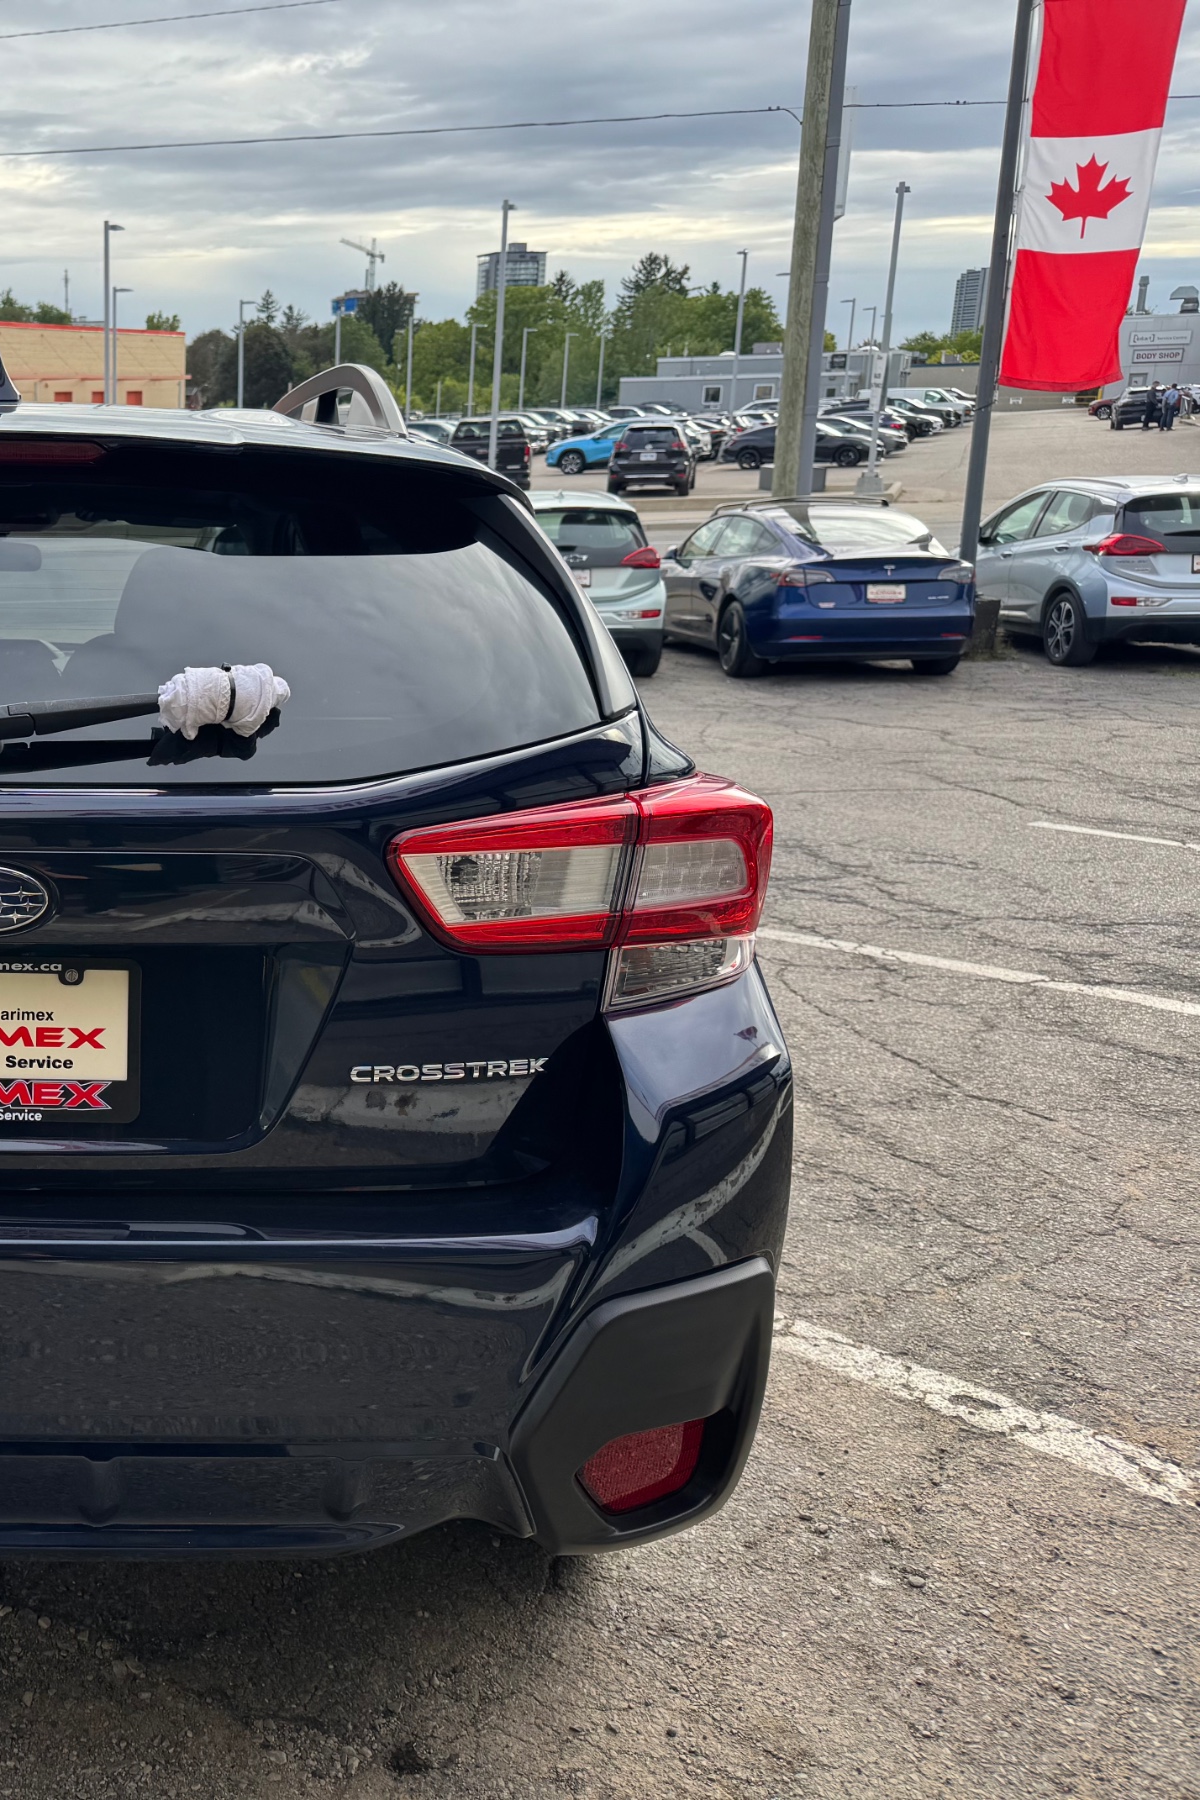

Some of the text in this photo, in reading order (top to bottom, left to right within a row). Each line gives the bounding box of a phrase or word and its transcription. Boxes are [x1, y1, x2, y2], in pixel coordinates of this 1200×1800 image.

[1136, 351, 1180, 360] BODY SHOP
[5, 1055, 74, 1069] Service
[350, 1057, 549, 1083] CROSSTREK
